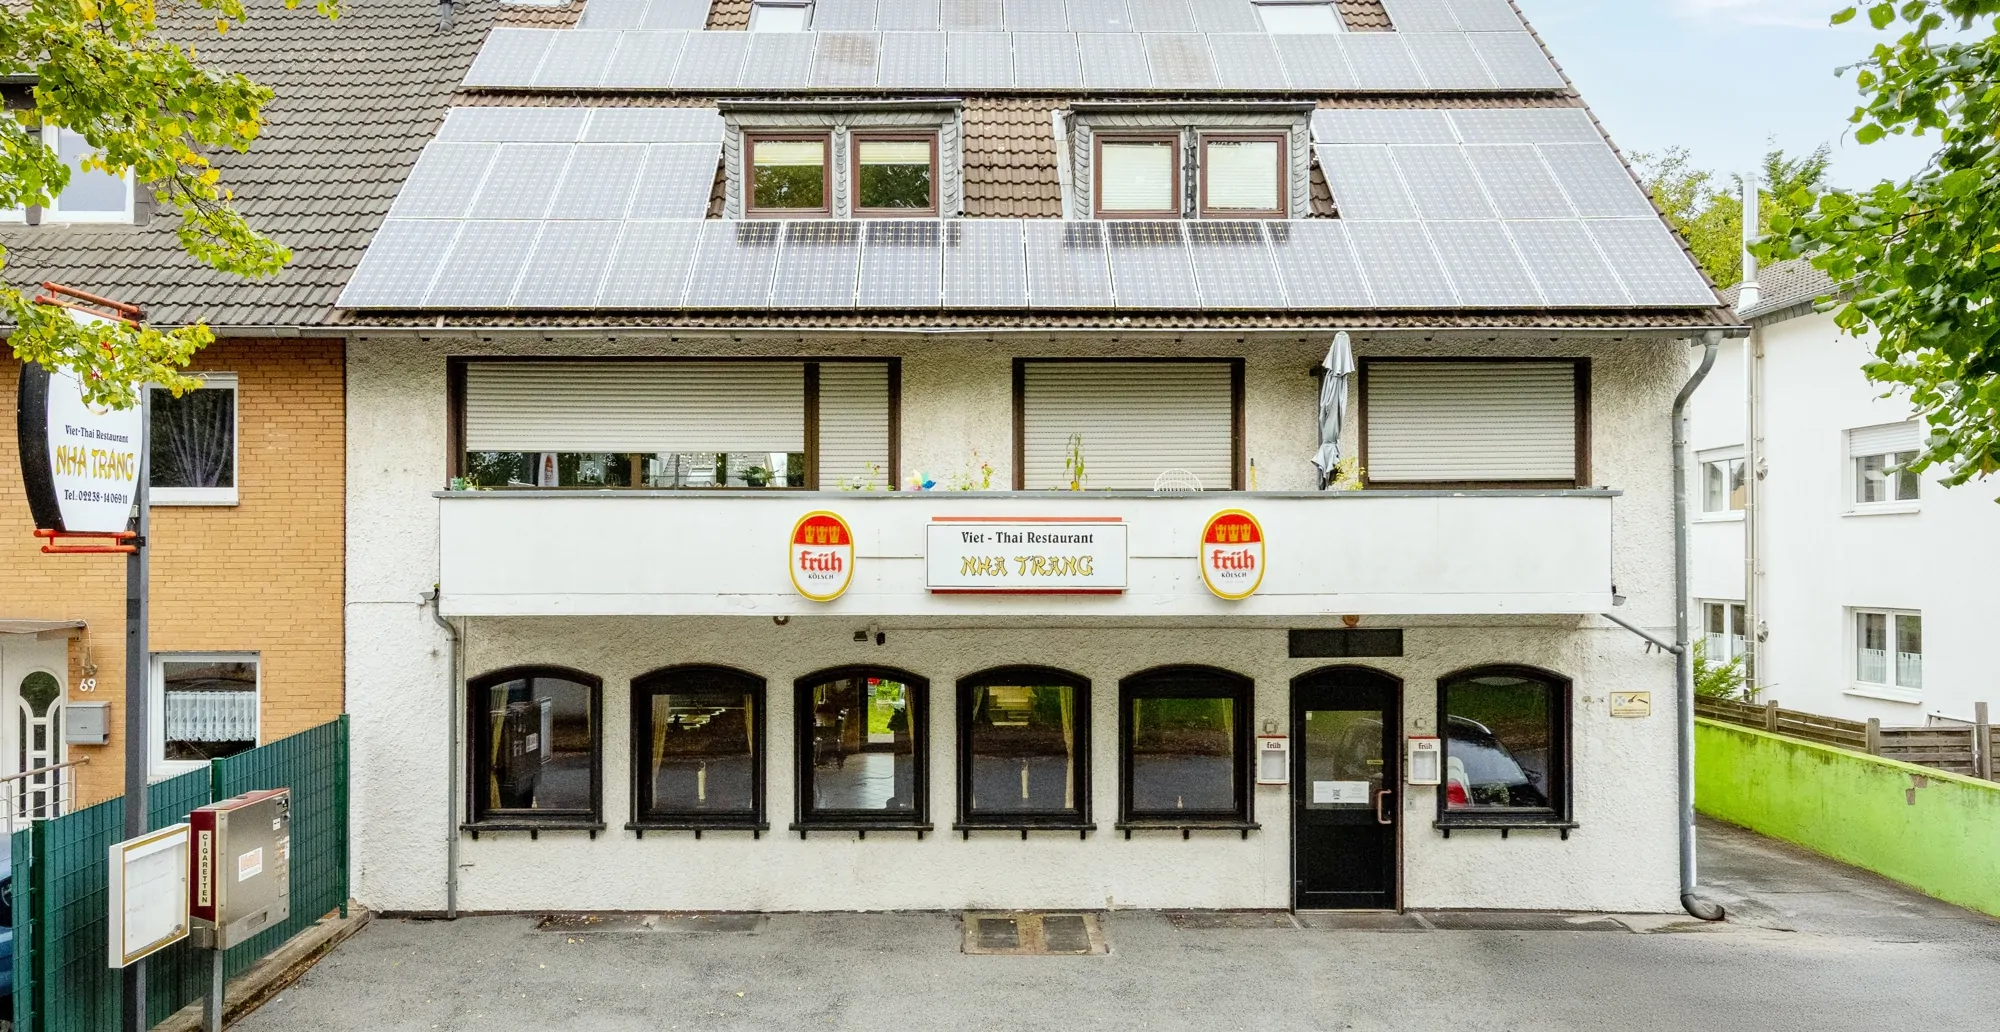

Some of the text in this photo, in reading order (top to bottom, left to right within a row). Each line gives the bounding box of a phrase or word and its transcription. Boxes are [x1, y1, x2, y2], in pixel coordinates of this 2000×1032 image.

[65, 424, 129, 443] Viet-Thai Restaurant
[56, 444, 134, 482] NHA TRANG
[961, 531, 984, 544] Viet
[996, 531, 1023, 544] Thai
[1027, 531, 1094, 544] Restaurant
[799, 549, 843, 573] früh
[960, 555, 1094, 577] NHA TRANG
[1211, 548, 1255, 571] früh
[80, 678, 97, 692] 69
